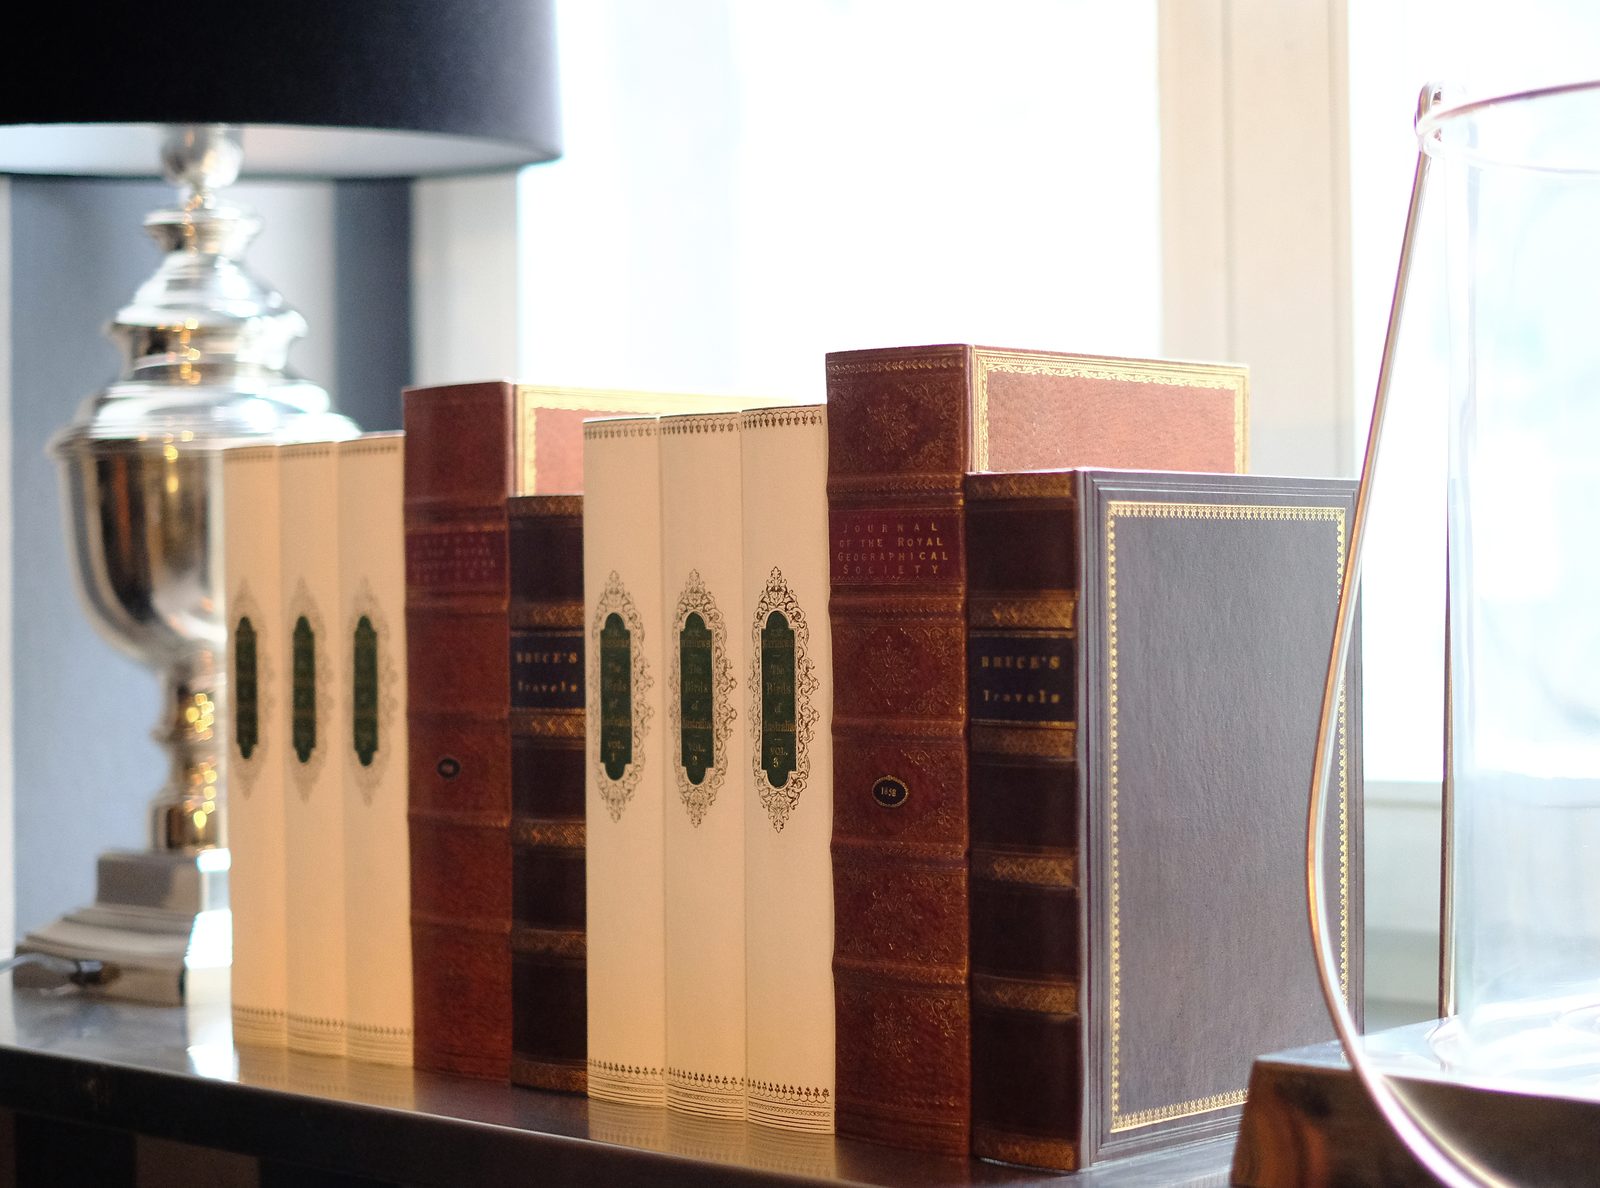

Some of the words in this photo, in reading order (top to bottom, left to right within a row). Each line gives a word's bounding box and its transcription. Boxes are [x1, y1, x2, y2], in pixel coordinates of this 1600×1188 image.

[843, 521, 939, 533] JOURNAL
[839, 539, 851, 548] OF
[861, 538, 883, 548] THE
[897, 536, 943, 548] ROYAL
[837, 551, 948, 561] GEOGRAPHICAL
[842, 564, 939, 575] SOCIETY
